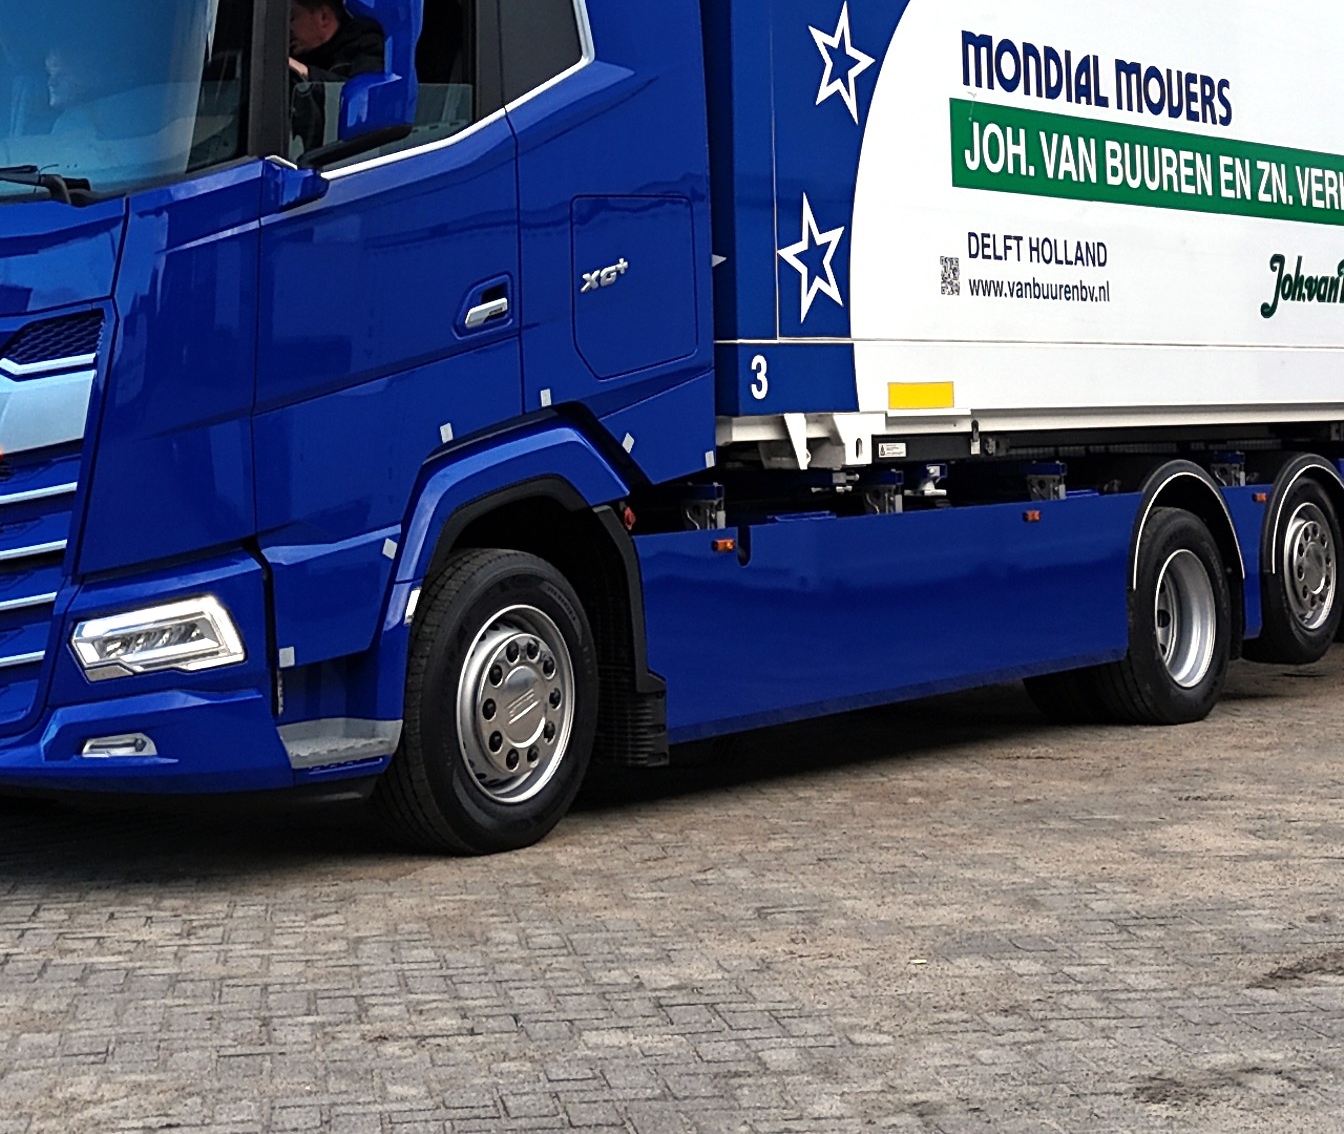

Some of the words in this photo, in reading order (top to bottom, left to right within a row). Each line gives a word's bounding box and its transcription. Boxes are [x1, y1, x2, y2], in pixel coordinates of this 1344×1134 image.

[961, 29, 1110, 109] MONDIAL
[964, 120, 1036, 177] JOH.
[1038, 130, 1097, 184] VAN
[1106, 139, 1213, 197] BUUREN
[1219, 154, 1252, 201] EN
[1256, 159, 1294, 206] ZN.
[967, 231, 1024, 261] DELFT
[1028, 236, 1108, 268] HOLLAND
[968, 276, 1111, 302] www.vanbuurenbv.nl
[750, 354, 769, 400] 3
